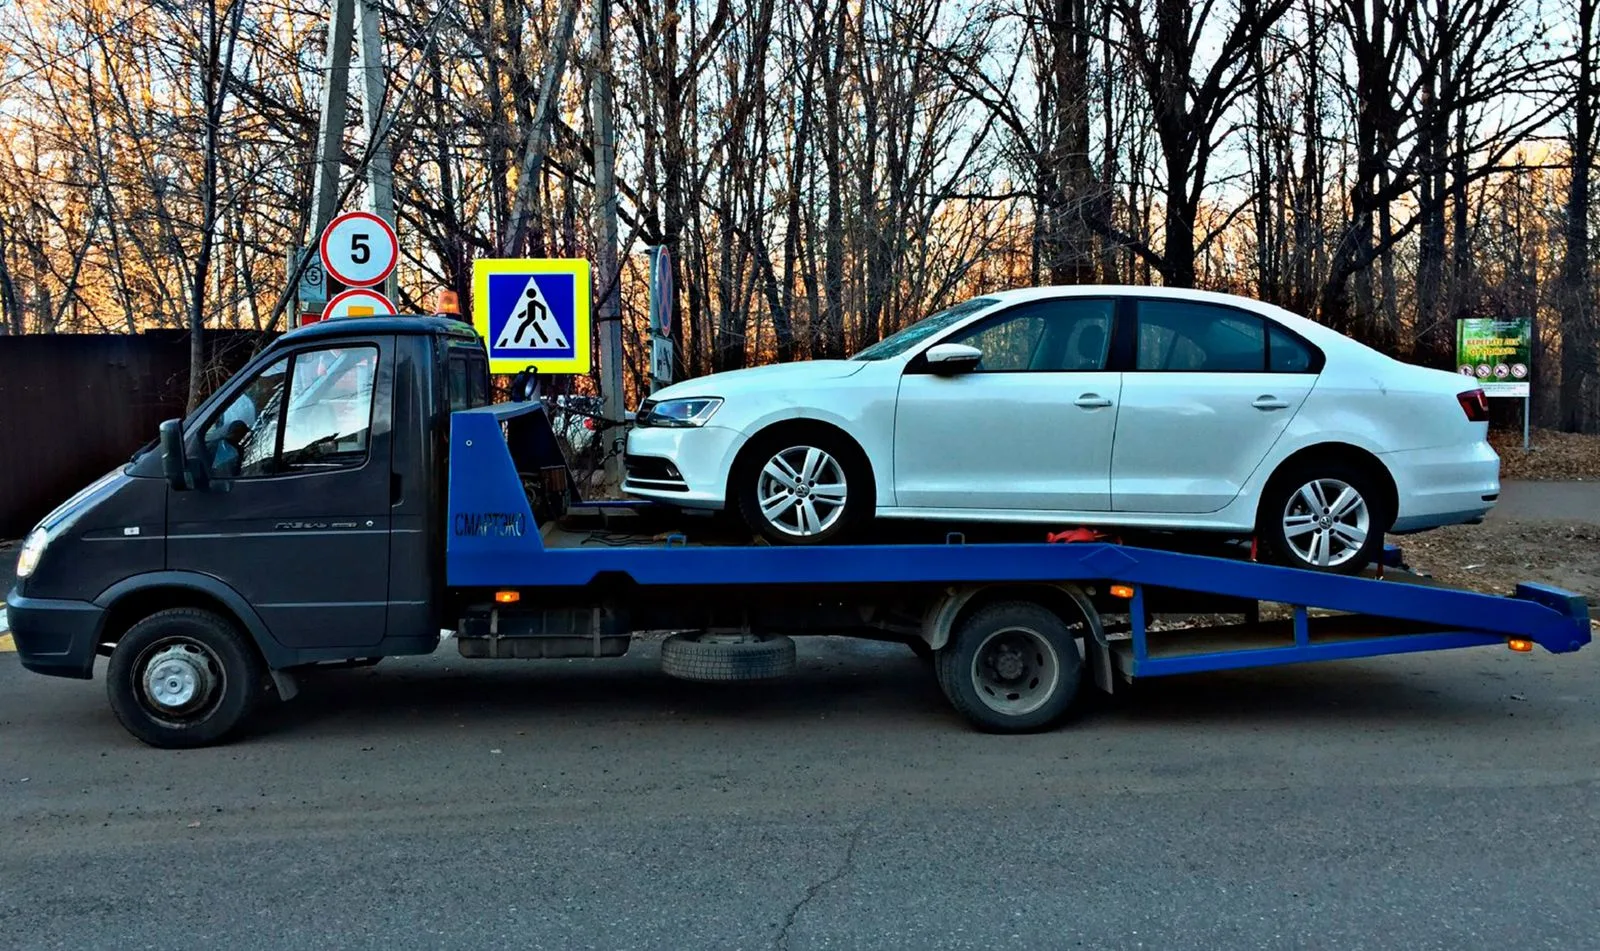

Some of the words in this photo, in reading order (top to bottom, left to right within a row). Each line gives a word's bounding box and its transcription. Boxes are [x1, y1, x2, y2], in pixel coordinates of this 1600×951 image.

[350, 233, 371, 265] 5
[311, 270, 319, 282] 5
[455, 512, 526, 536] СМАРТЭКО
